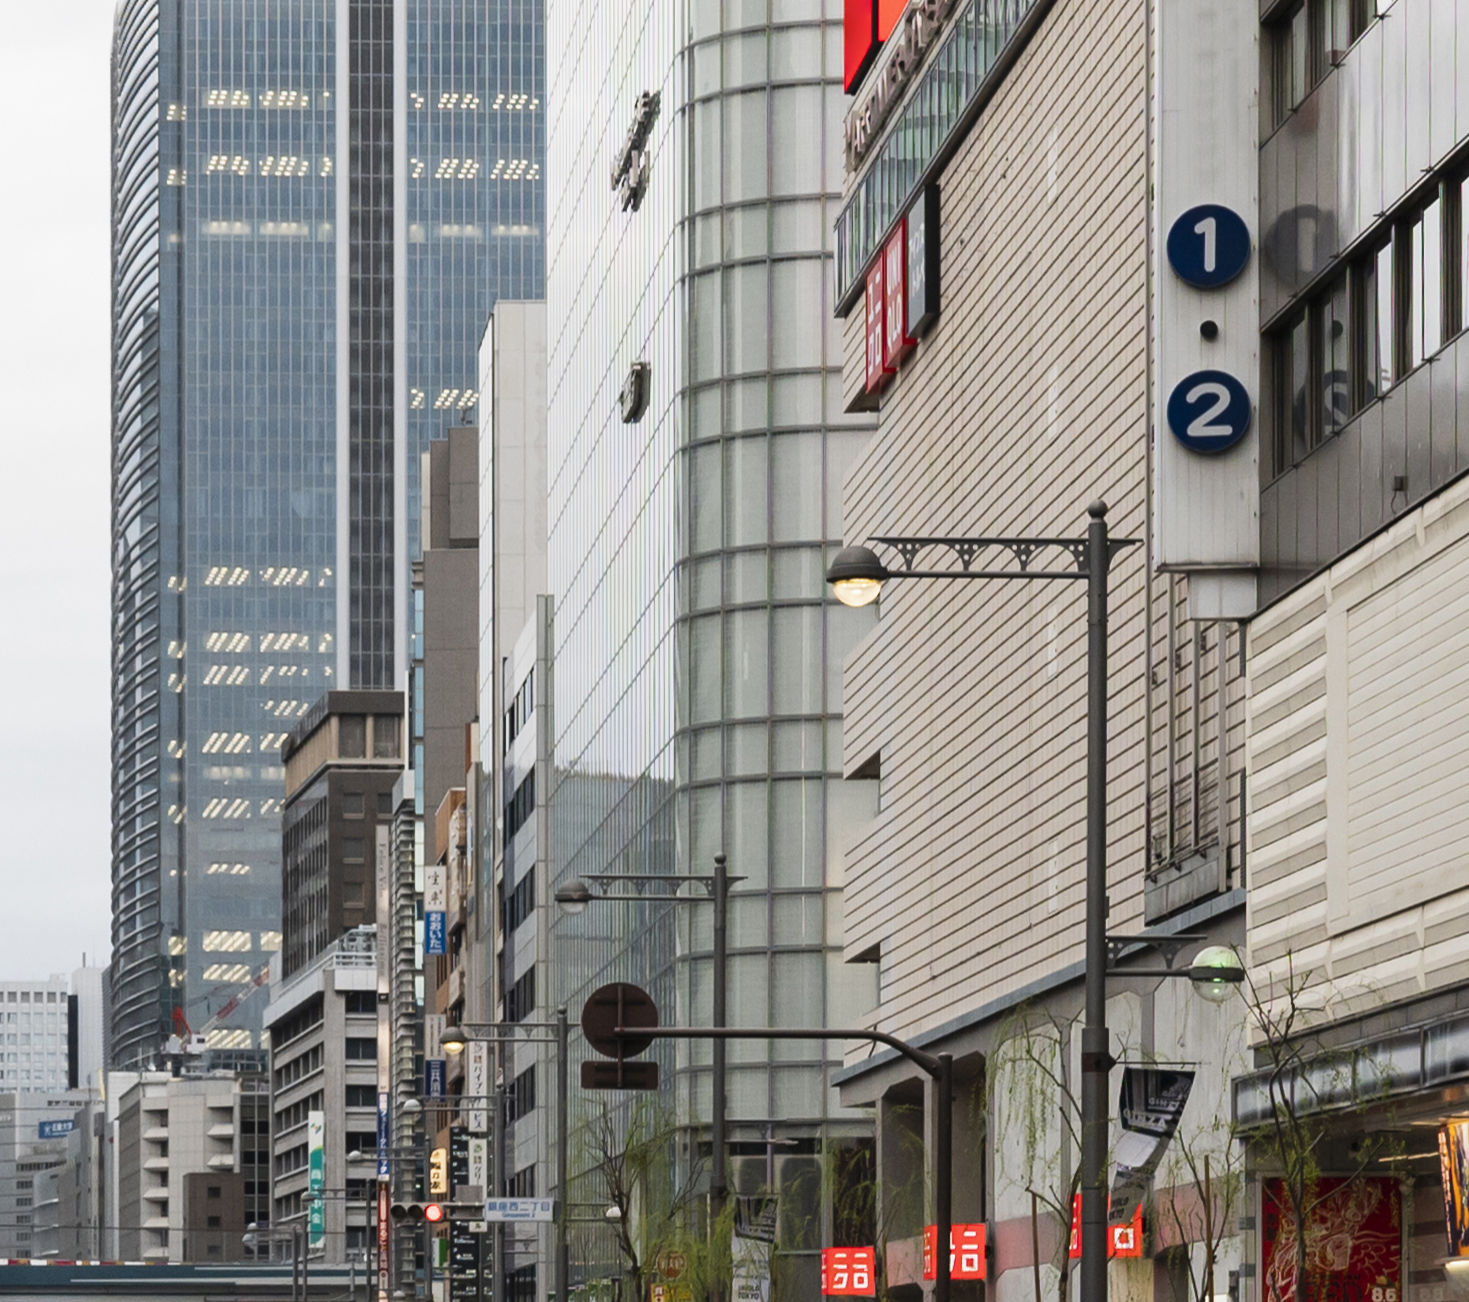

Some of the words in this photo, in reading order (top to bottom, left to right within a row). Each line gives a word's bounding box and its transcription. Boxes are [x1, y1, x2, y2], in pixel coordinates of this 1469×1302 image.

[887, 241, 901, 296] UNI
[887, 293, 901, 353] QLO
[429, 913, 442, 948] おおいた
[1123, 1108, 1167, 1129] GINZA
[488, 1202, 550, 1212] 銀座西二丁目
[1372, 1287, 1397, 1302] 8.6
